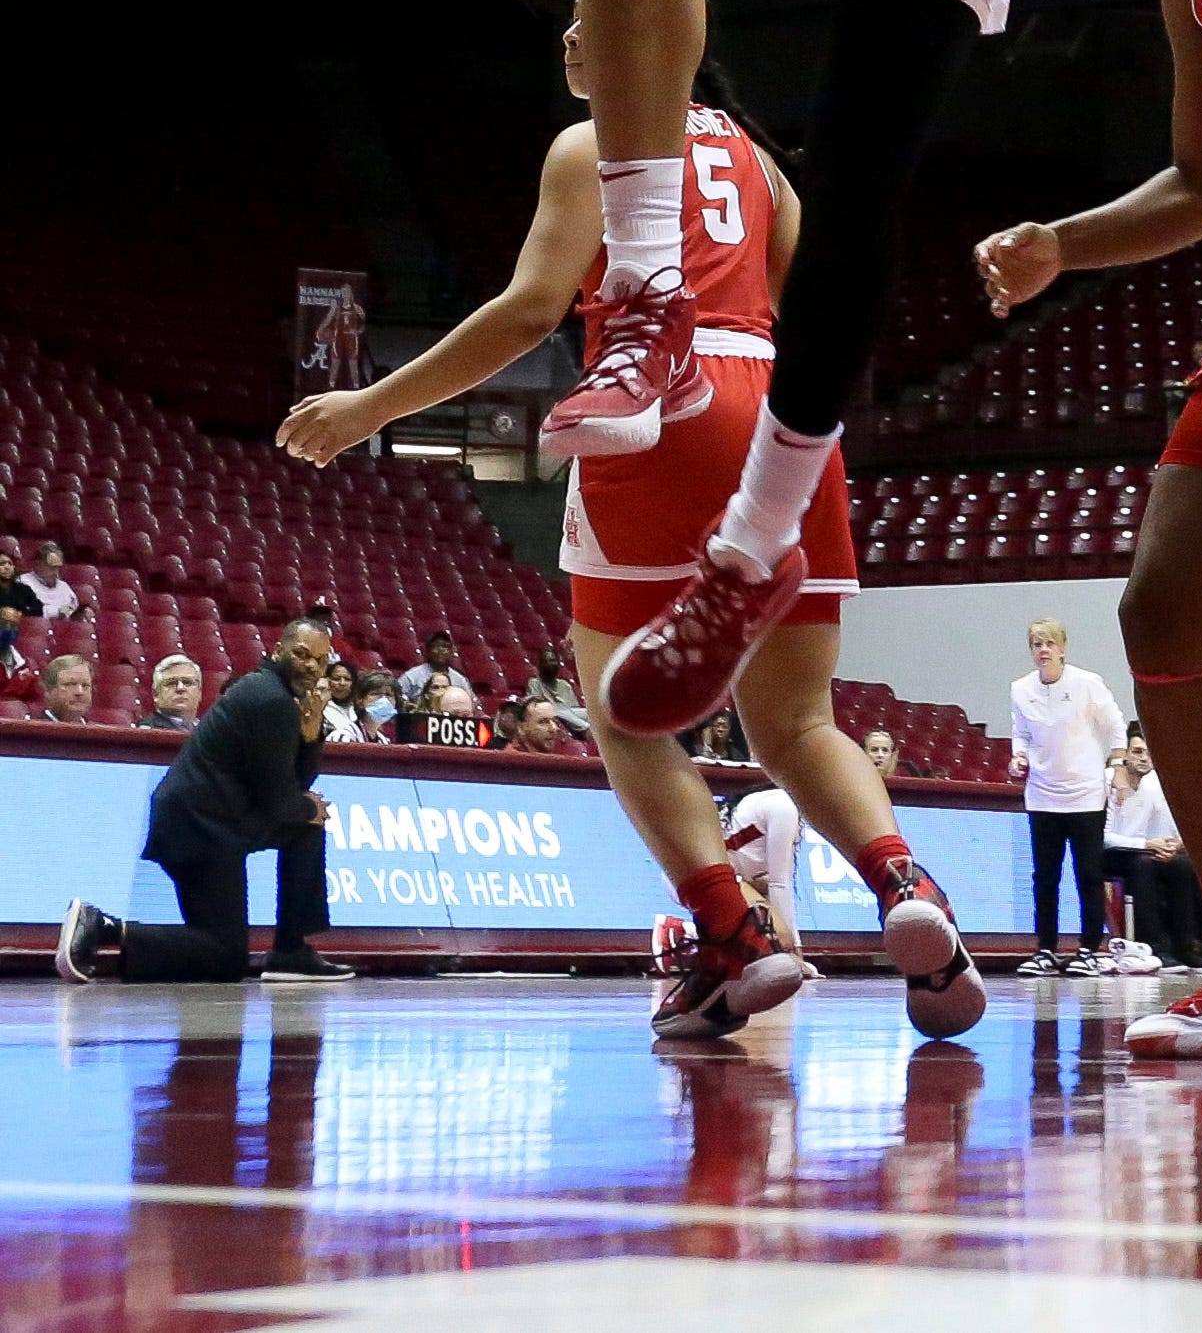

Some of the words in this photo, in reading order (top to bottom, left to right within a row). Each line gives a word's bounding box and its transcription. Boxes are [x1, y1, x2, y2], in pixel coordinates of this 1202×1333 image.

[691, 141, 748, 246] 5
[427, 716, 479, 747] POSS.
[366, 868, 461, 906] YOUR
[465, 871, 576, 908] HEALTH
